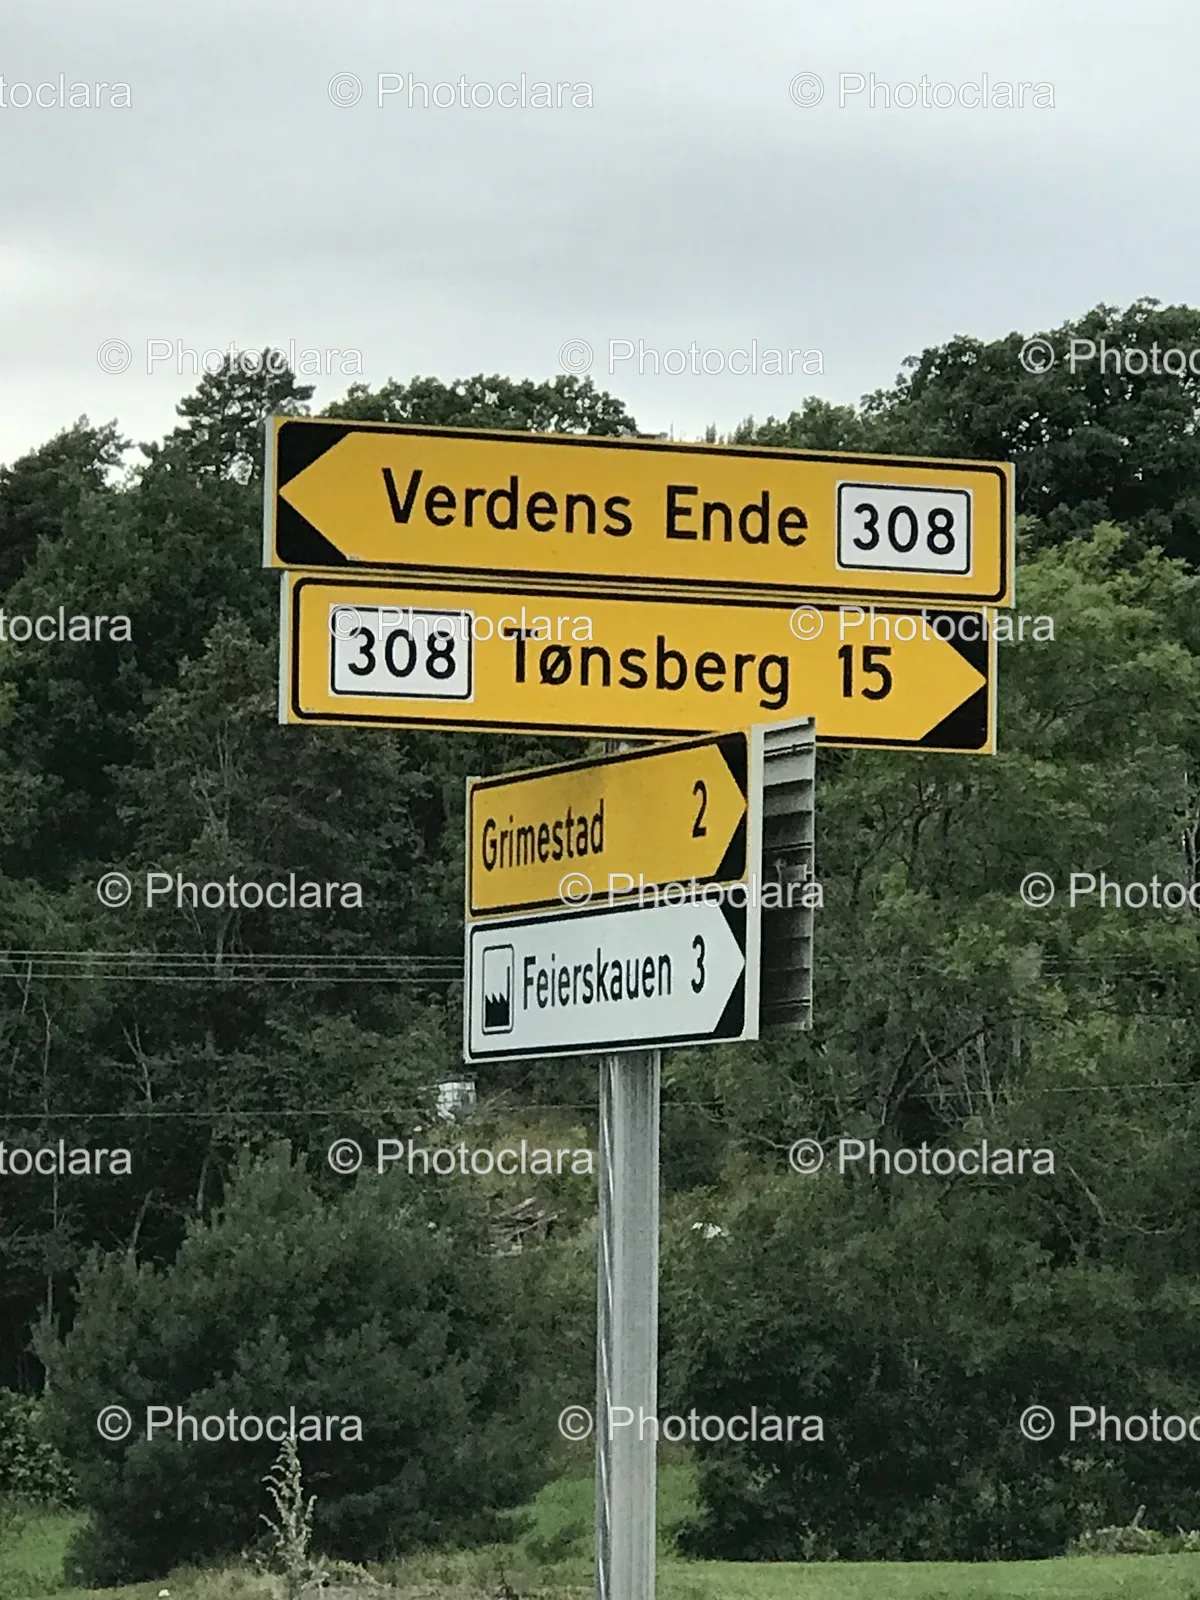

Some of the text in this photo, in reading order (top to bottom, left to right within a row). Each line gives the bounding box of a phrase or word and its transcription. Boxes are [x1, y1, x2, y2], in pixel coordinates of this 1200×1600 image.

[381, 467, 955, 555] Verdens Ende 308
[348, 626, 893, 711] 308 Tønsberg 15
[482, 779, 707, 872] Grimestad 2
[523, 934, 705, 1010] Feierskauen 3
